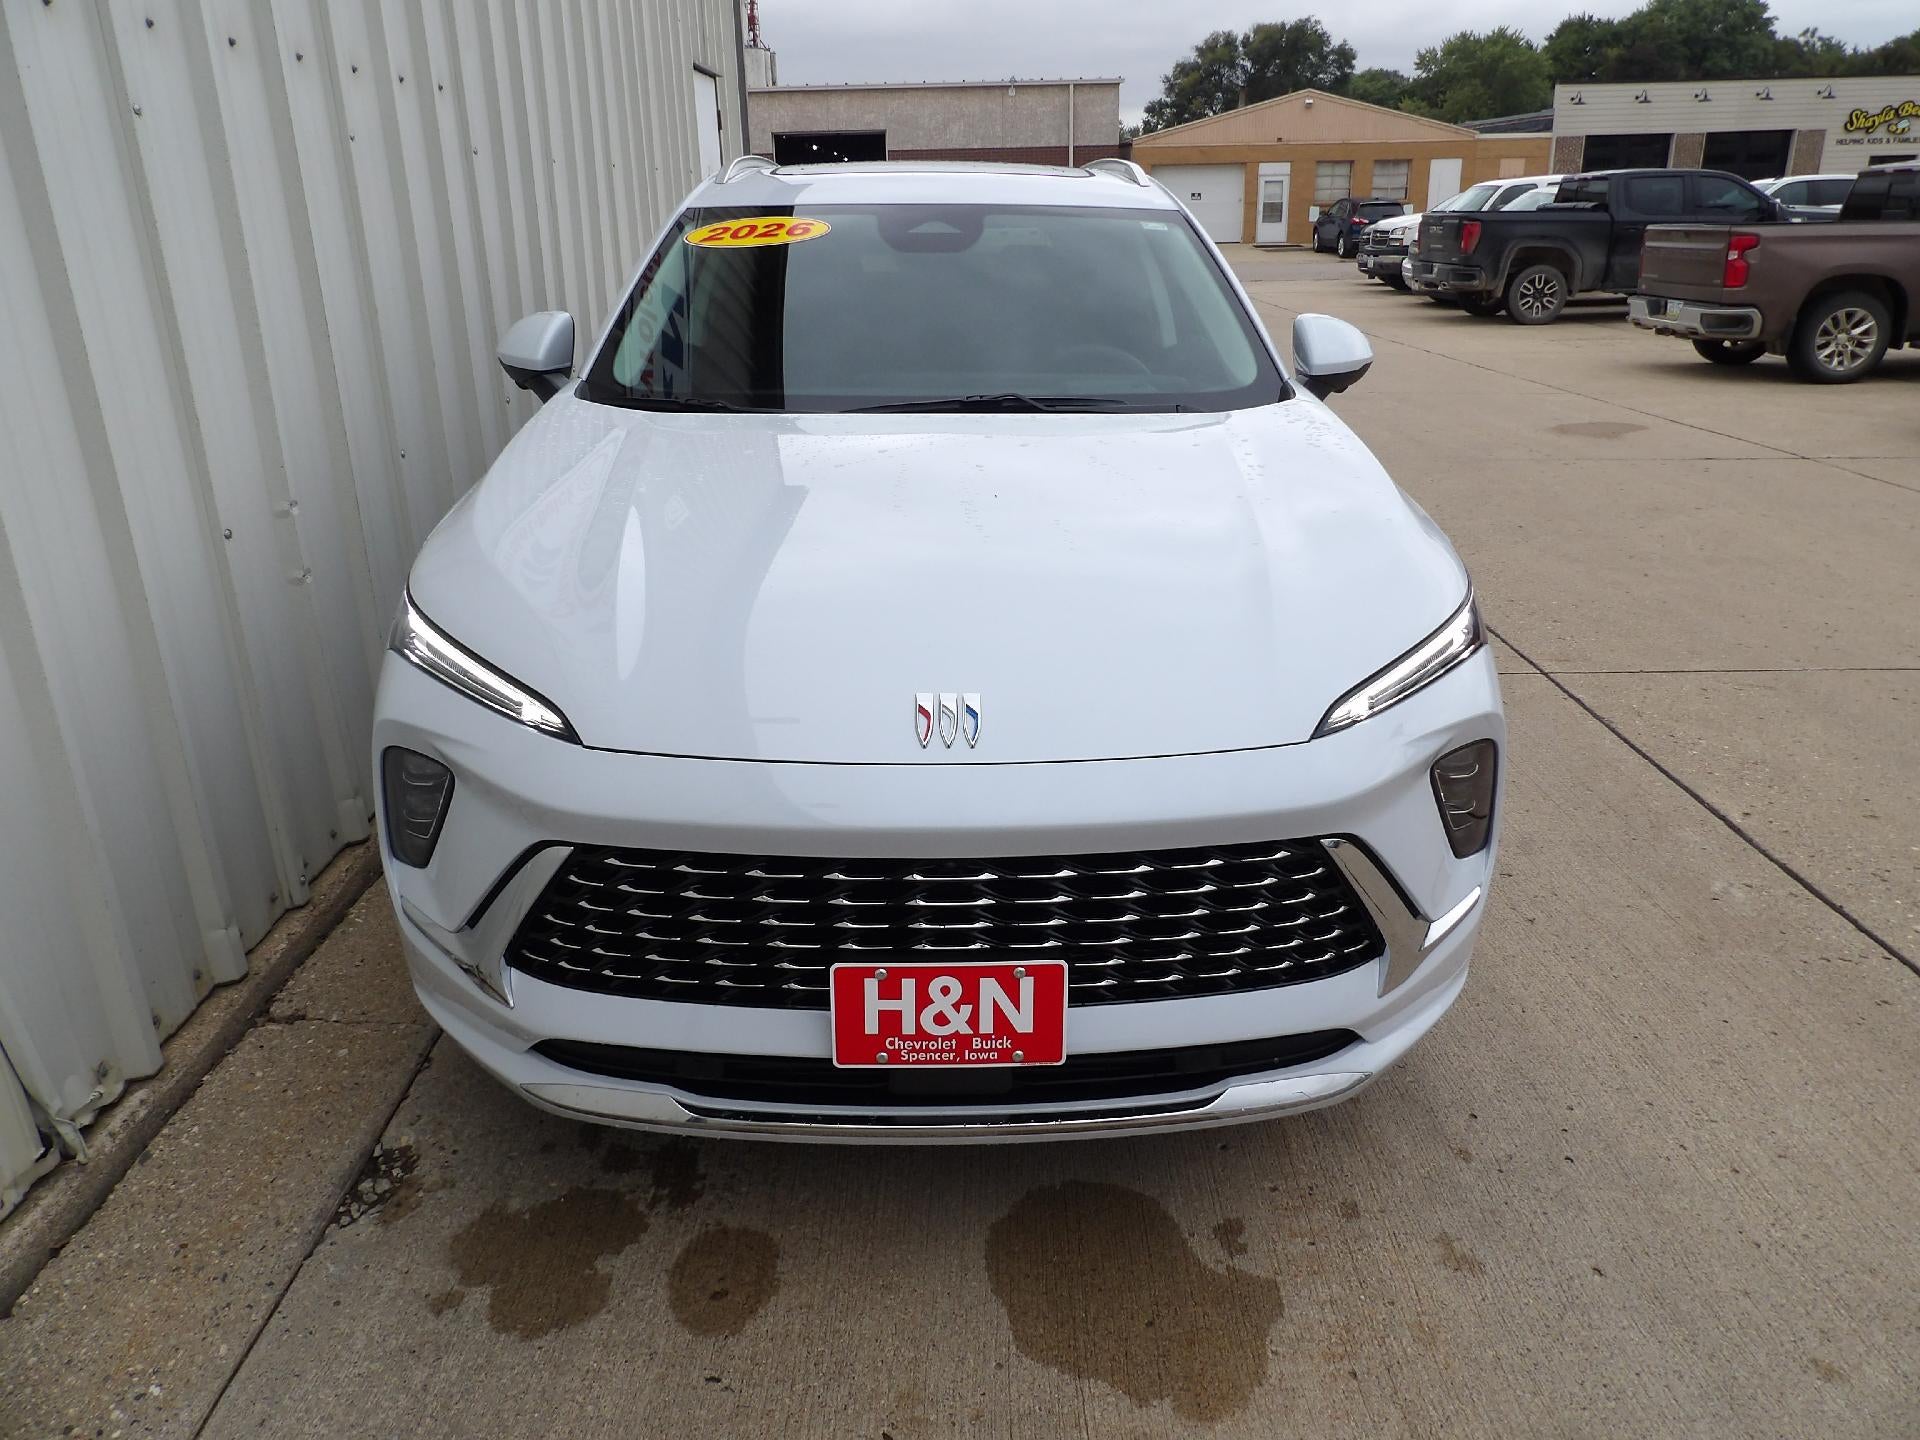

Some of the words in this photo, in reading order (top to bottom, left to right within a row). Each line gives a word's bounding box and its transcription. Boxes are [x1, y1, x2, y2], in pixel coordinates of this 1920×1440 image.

[698, 222, 816, 243] 2026
[863, 975, 1035, 1036] H&N
[885, 1037, 957, 1050] Chevrolet
[972, 1035, 1012, 1050] Buick
[900, 1050, 961, 1062] Spencer,
[964, 1049, 998, 1060] Iowa
